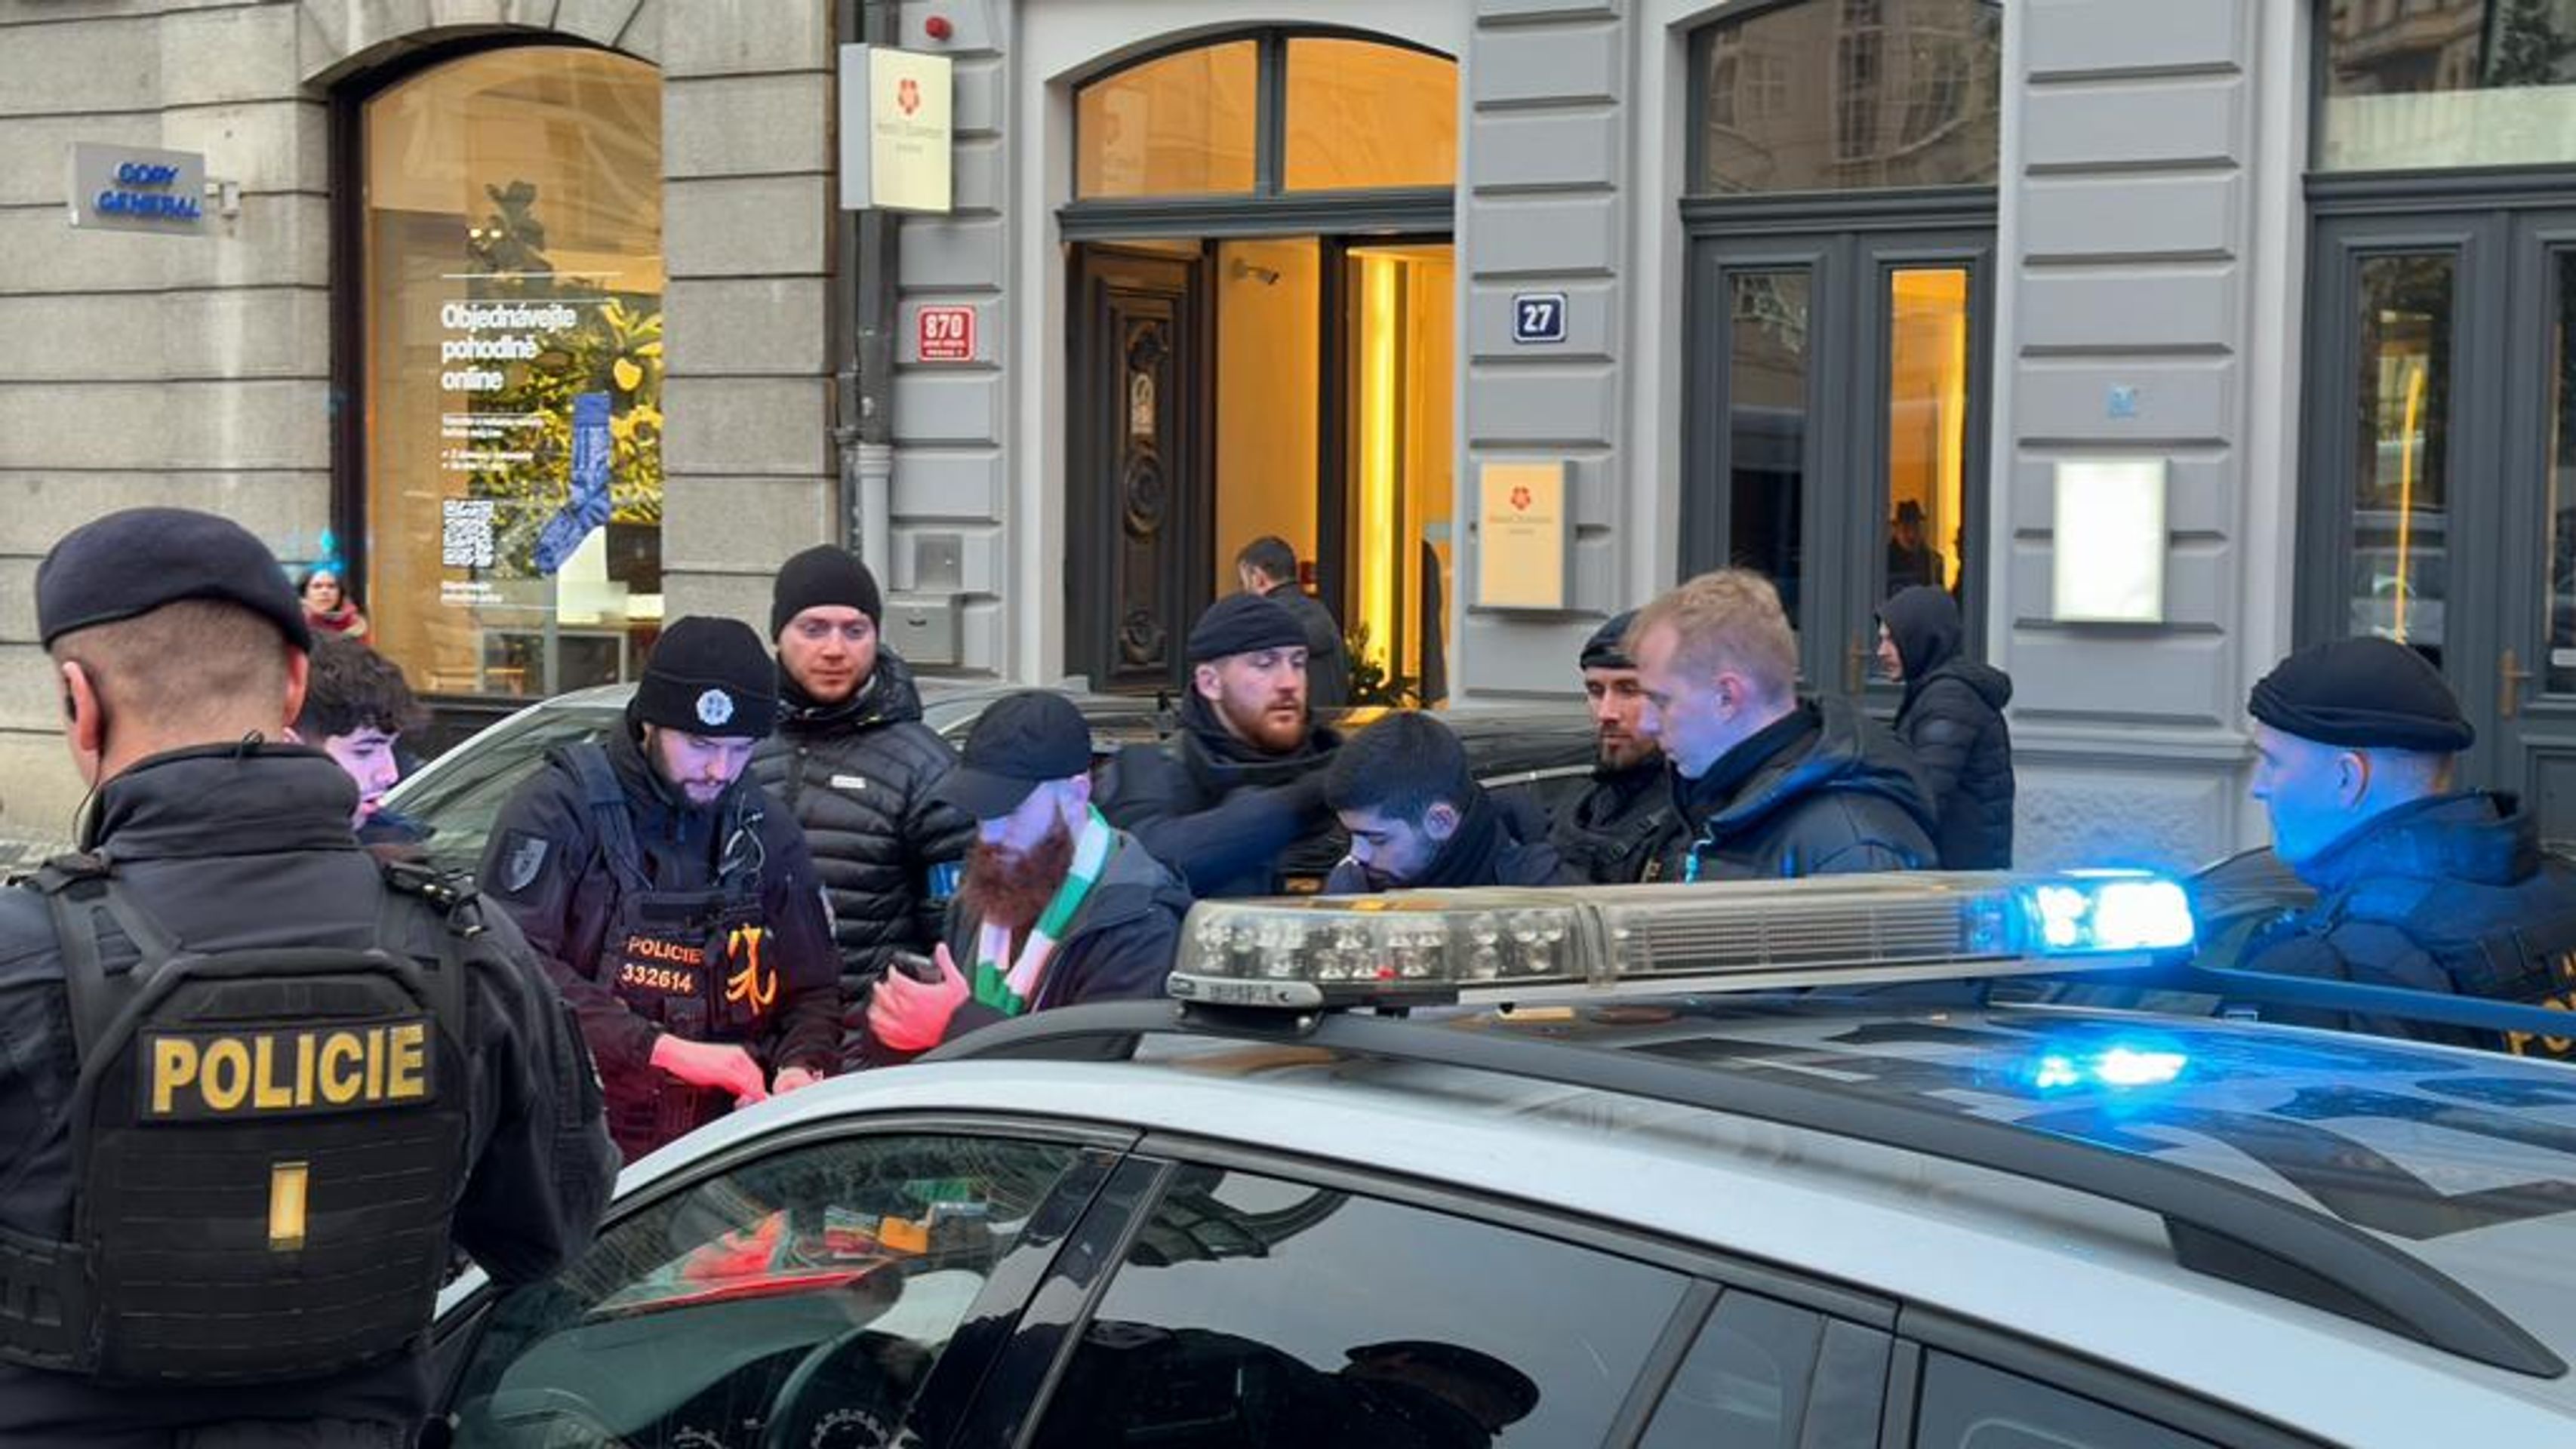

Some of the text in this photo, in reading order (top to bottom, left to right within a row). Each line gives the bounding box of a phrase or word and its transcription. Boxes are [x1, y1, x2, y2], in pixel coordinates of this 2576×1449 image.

[95, 189, 202, 219] GENERAL
[441, 303, 577, 333] Objednávejte
[925, 313, 963, 339] 870
[1523, 303, 1553, 332] 27
[442, 334, 538, 364] pohodlně
[442, 365, 504, 391] online
[628, 935, 703, 964] POLICIE
[621, 963, 693, 993] 332614
[152, 1023, 424, 1113] POLICIE
